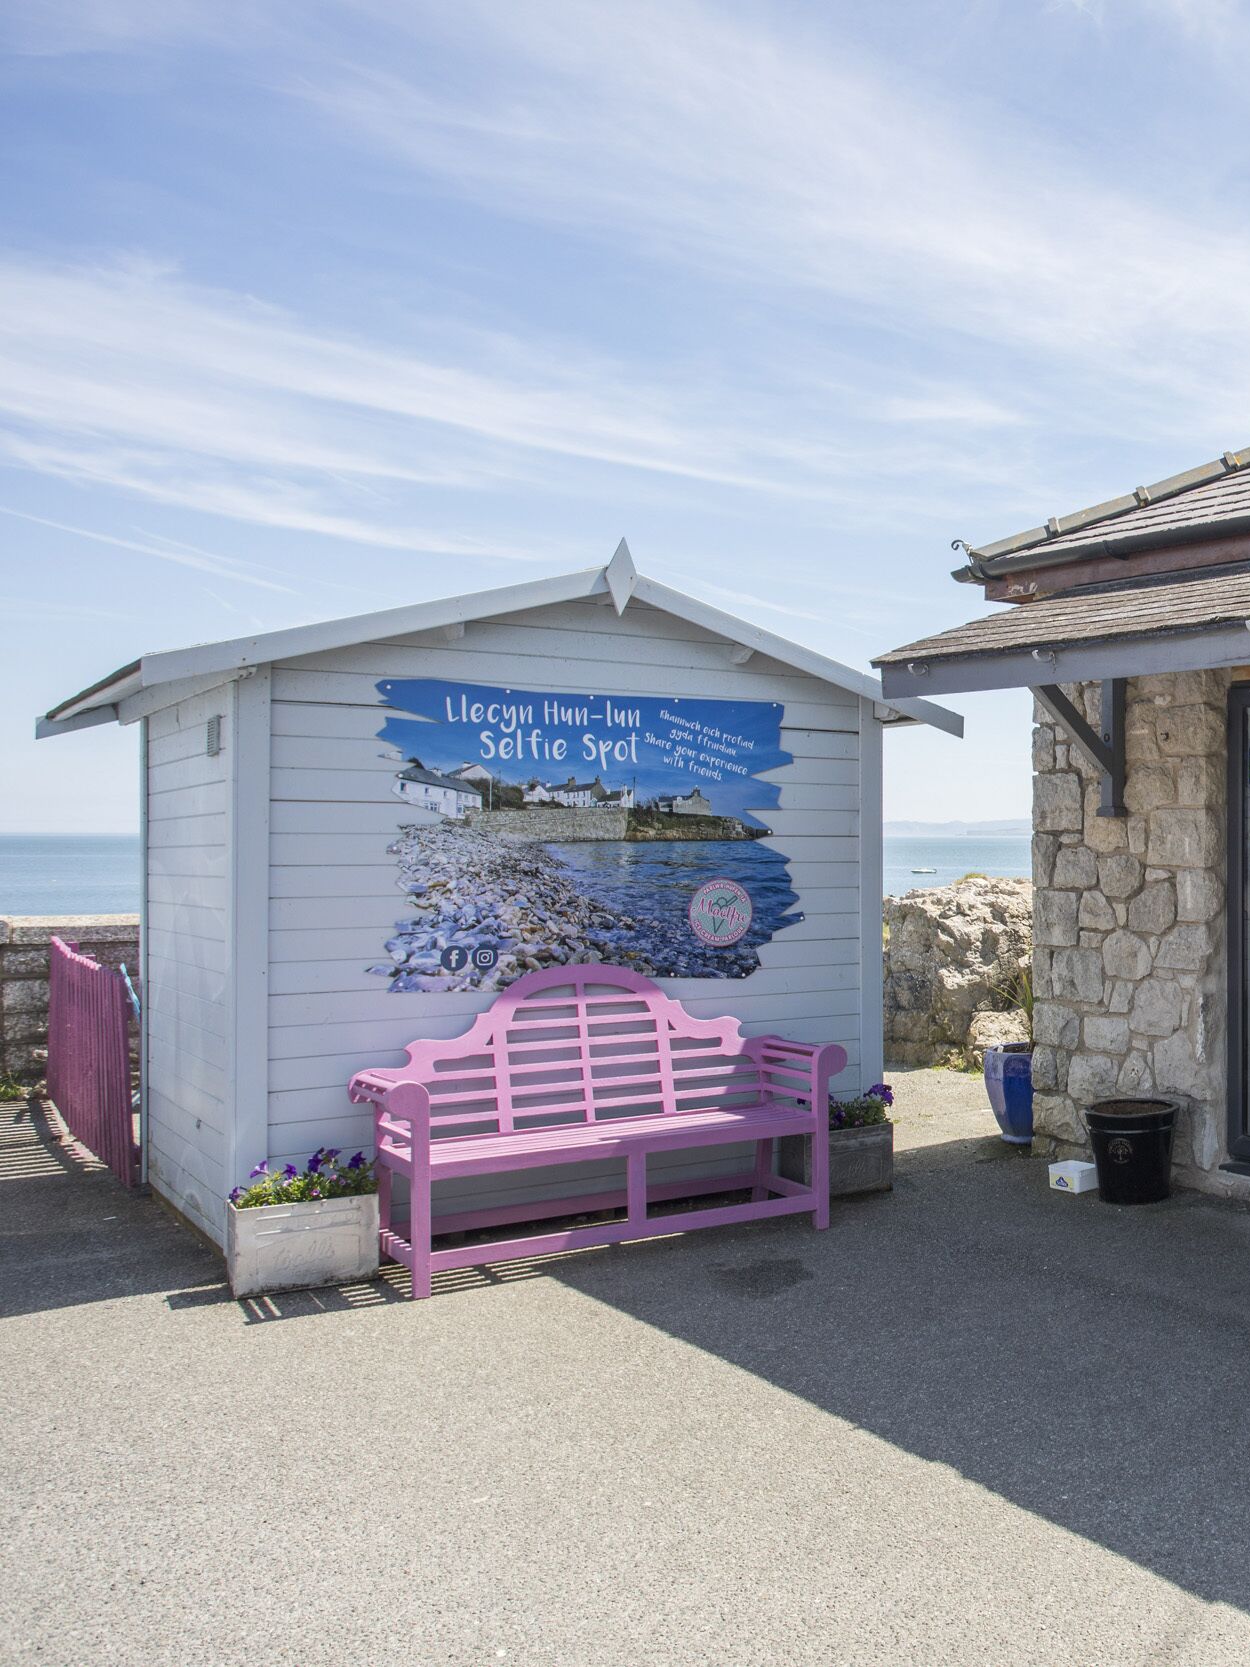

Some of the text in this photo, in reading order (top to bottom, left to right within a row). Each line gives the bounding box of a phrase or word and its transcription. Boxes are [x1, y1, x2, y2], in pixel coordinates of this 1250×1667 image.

[446, 693, 641, 733] Llecyn Hun-lun
[479, 728, 641, 771] Selfie Spot
[669, 728, 694, 741] gyda
[703, 726, 721, 738] eich
[722, 732, 755, 750] profiad
[644, 732, 748, 776] Share your experience
[663, 755, 684, 769] with
